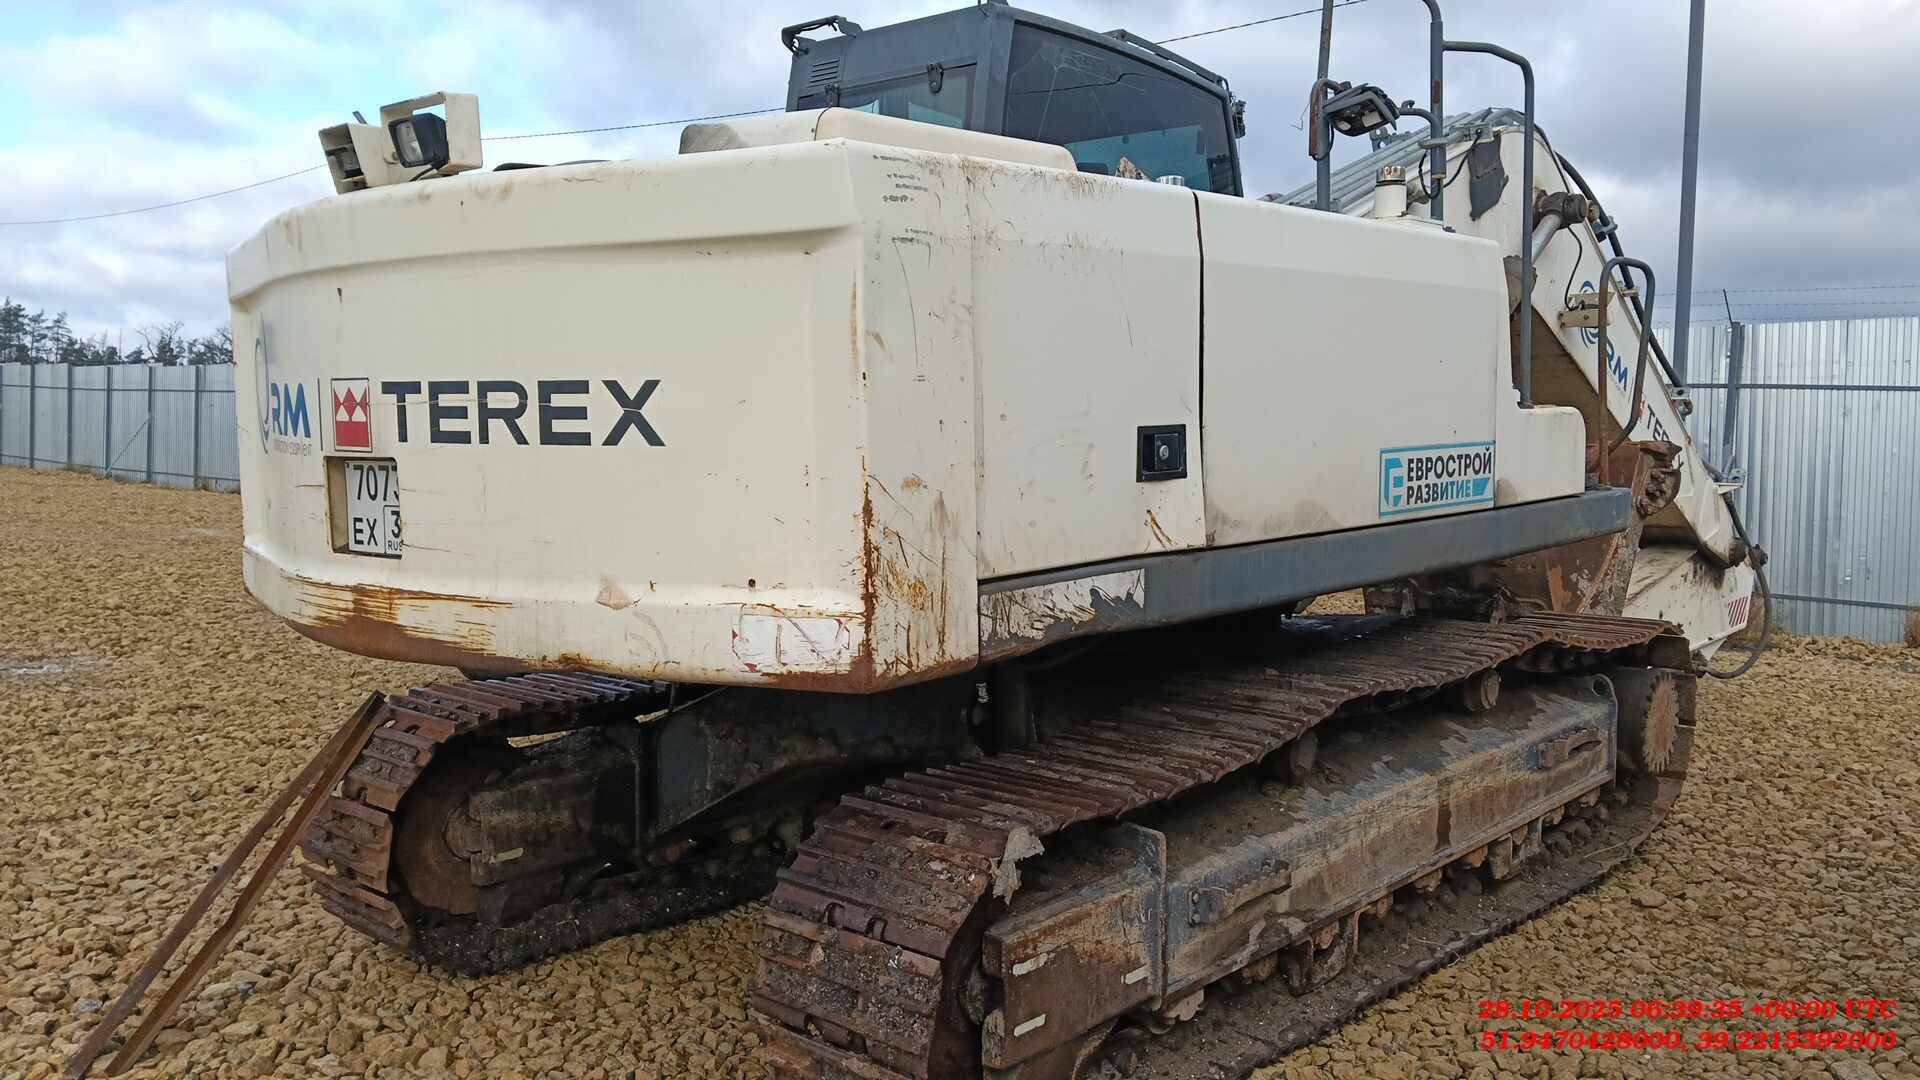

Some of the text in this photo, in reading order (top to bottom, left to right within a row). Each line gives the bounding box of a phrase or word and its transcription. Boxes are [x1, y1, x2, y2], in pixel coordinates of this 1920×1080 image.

[381, 379, 666, 447] TEREX
[1407, 445, 1493, 482] ЕВРОСТРОЙ
[1406, 479, 1471, 505] РАЗВИТИЕ
